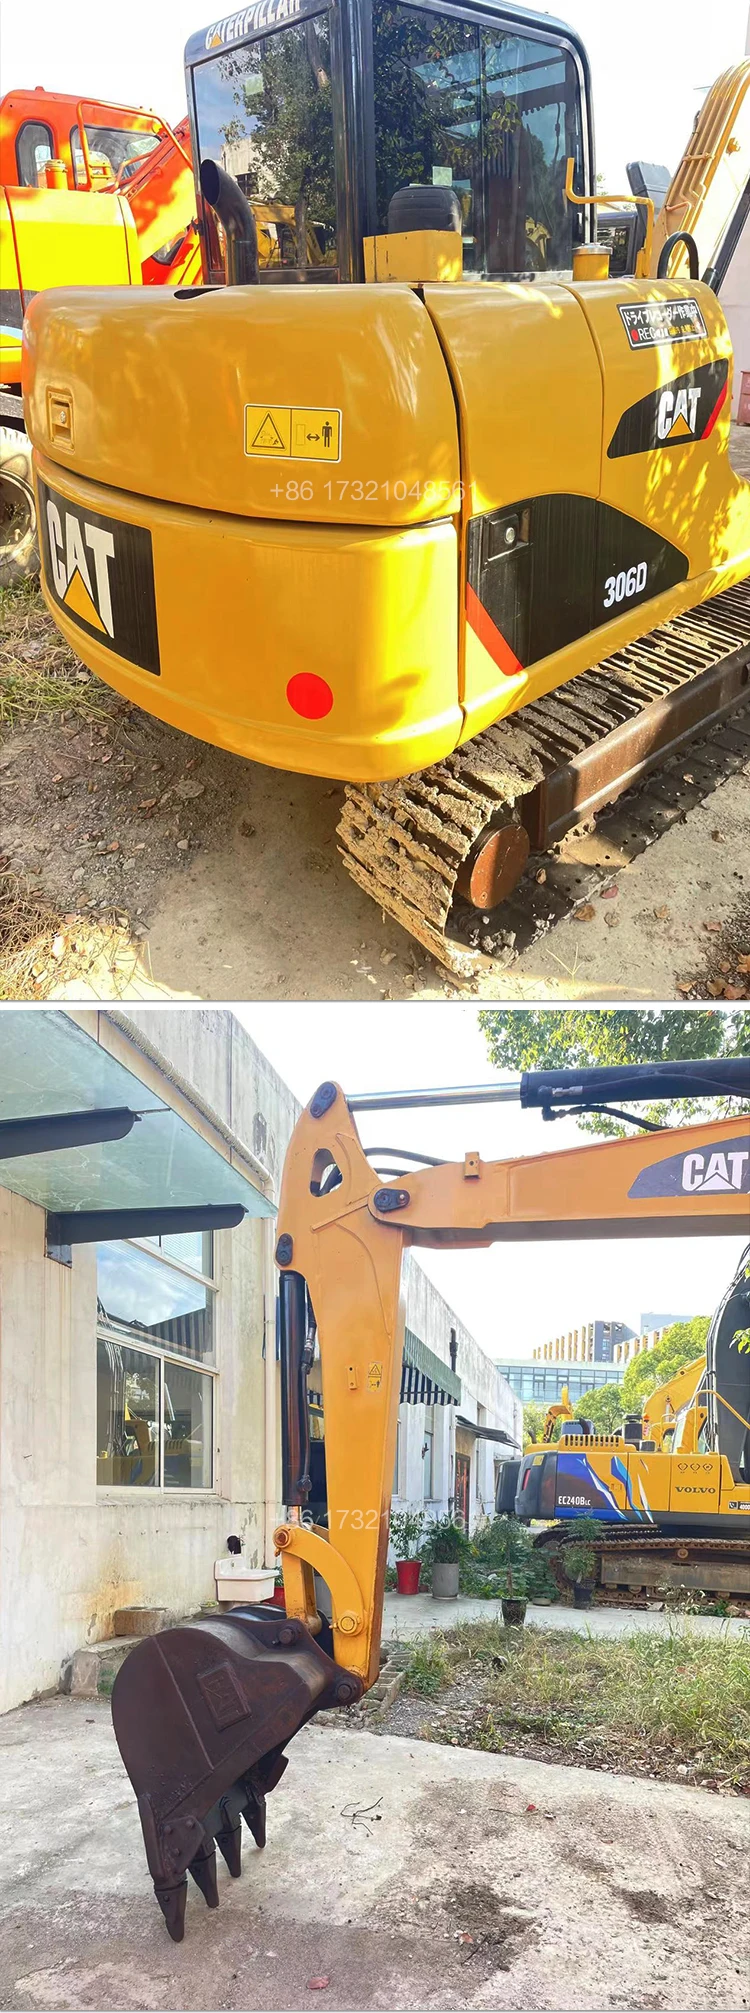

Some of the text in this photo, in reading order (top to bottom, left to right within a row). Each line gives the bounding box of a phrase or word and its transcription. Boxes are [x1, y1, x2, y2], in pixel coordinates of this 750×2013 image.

[205, 0, 301, 50] CATERPILLAR
[657, 387, 701, 439] CAT
[47, 500, 115, 639] CAT
[603, 561, 648, 608] 306D
[682, 1151, 749, 1191] CAT
[675, 1486, 716, 1494] VOLVO
